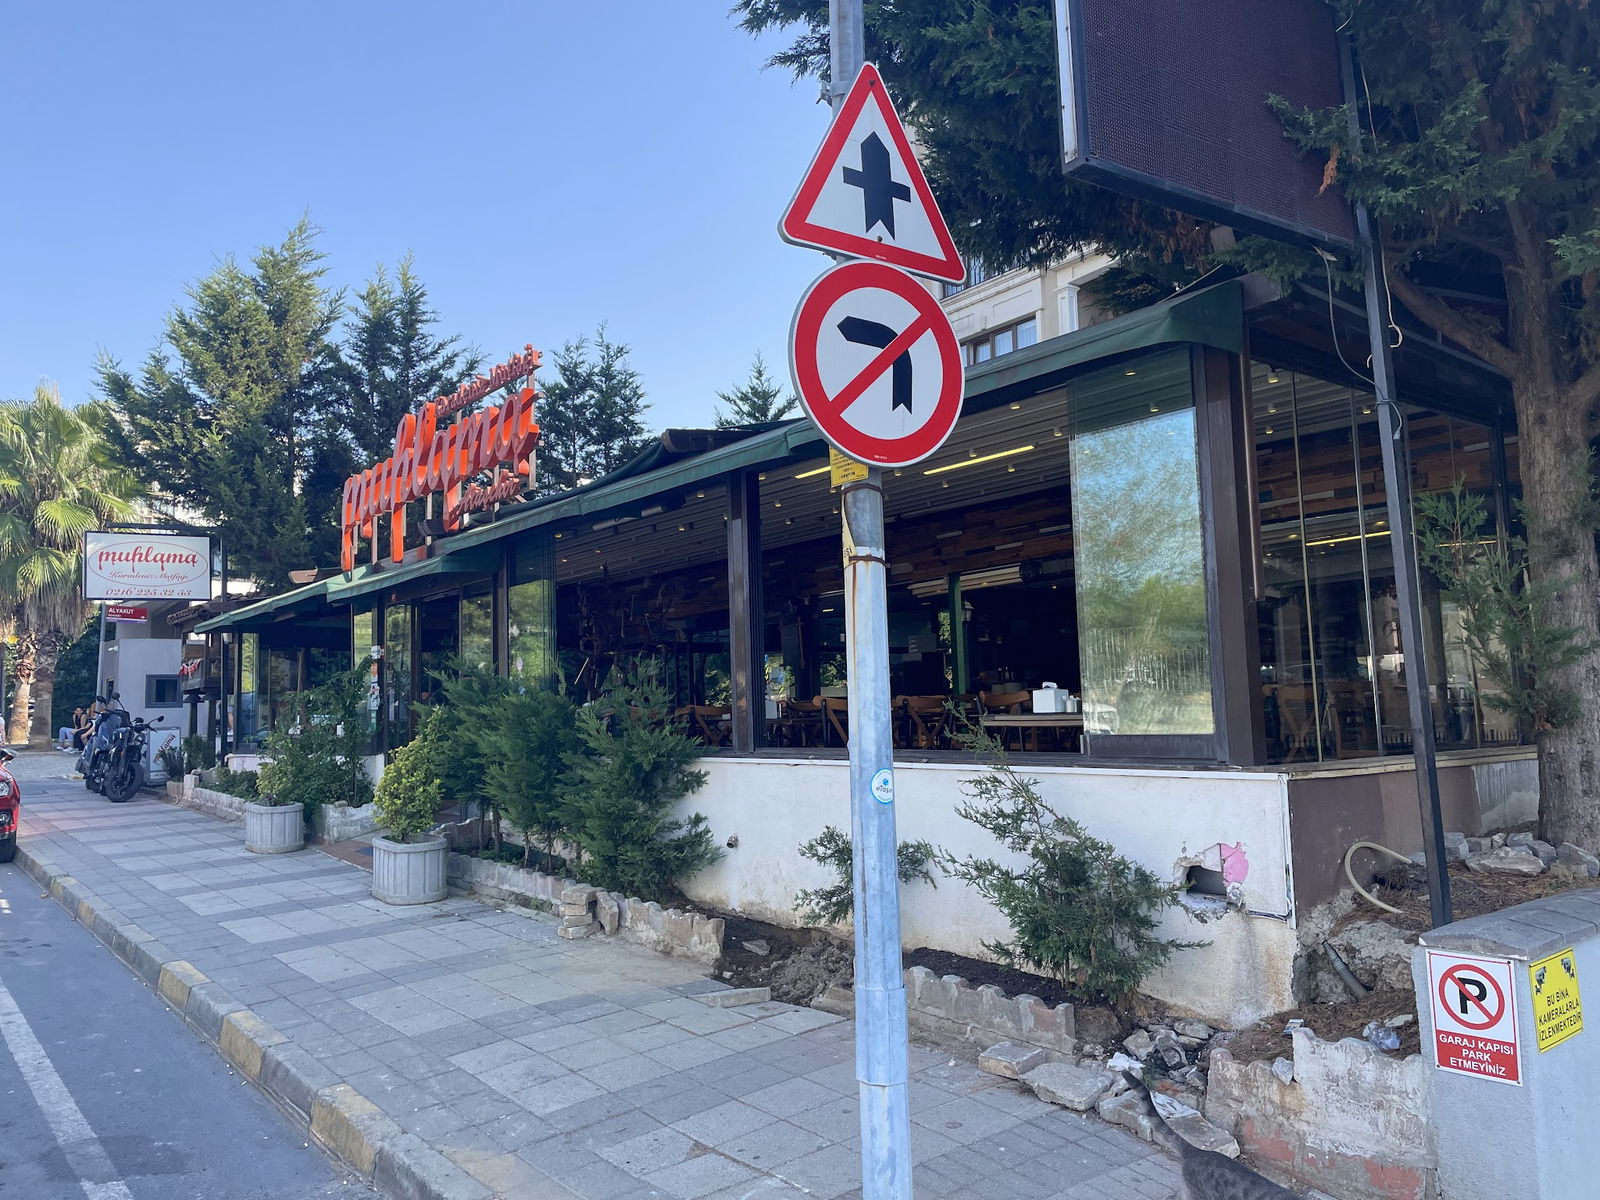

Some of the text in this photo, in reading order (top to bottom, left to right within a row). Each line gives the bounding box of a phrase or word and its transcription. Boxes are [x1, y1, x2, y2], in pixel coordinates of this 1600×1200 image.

[341, 387, 539, 572] muhlama
[98, 545, 198, 573] muhlama
[108, 571, 153, 579] Karadeniz
[106, 586, 136, 596] 0216
[108, 607, 134, 615] ALYAKUT
[1547, 994, 1555, 1007] BU
[1538, 997, 1579, 1027] KAMERALARLA
[1538, 1010, 1583, 1042] İZLENMEKTEDİR
[1439, 1033, 1514, 1056] GARAJ KAPISI
[1462, 1048, 1492, 1063] PARK
[1450, 1056, 1506, 1077] ETMEYİNİZ
